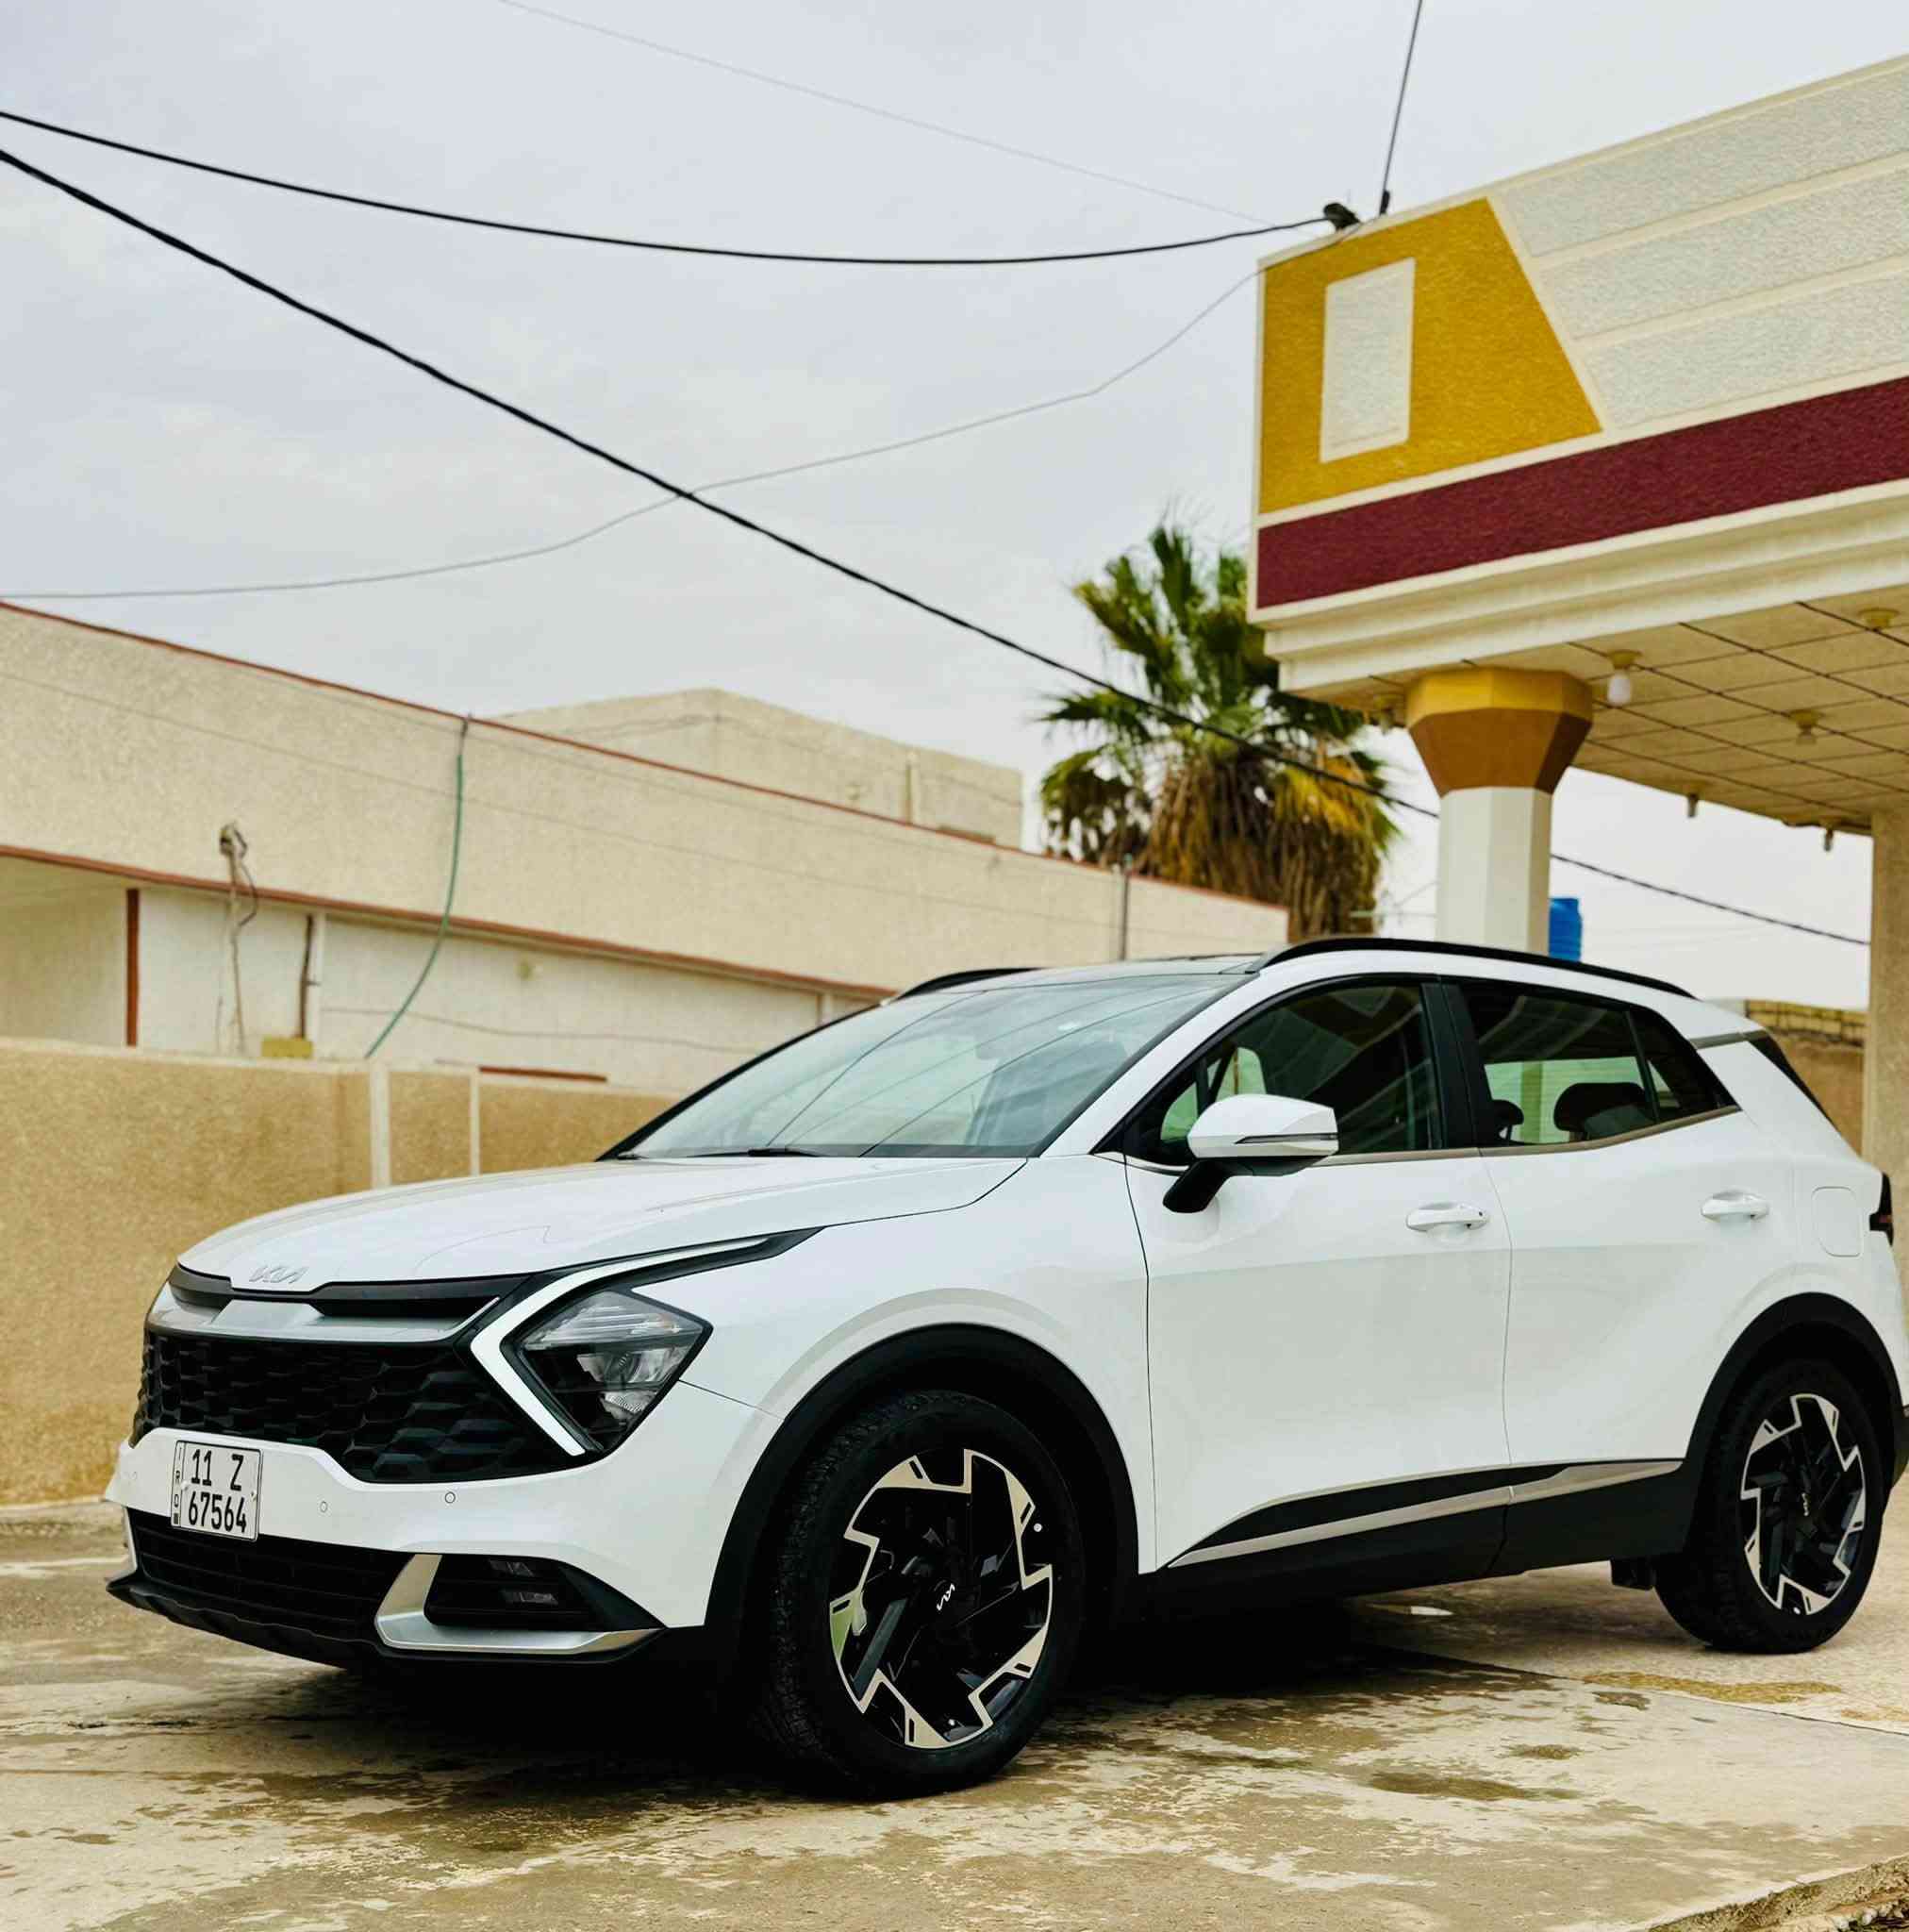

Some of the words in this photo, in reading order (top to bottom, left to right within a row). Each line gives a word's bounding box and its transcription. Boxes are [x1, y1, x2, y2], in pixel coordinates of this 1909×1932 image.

[191, 1448, 212, 1487] 11
[229, 1454, 244, 1491] Z
[189, 1491, 247, 1534] 67564
